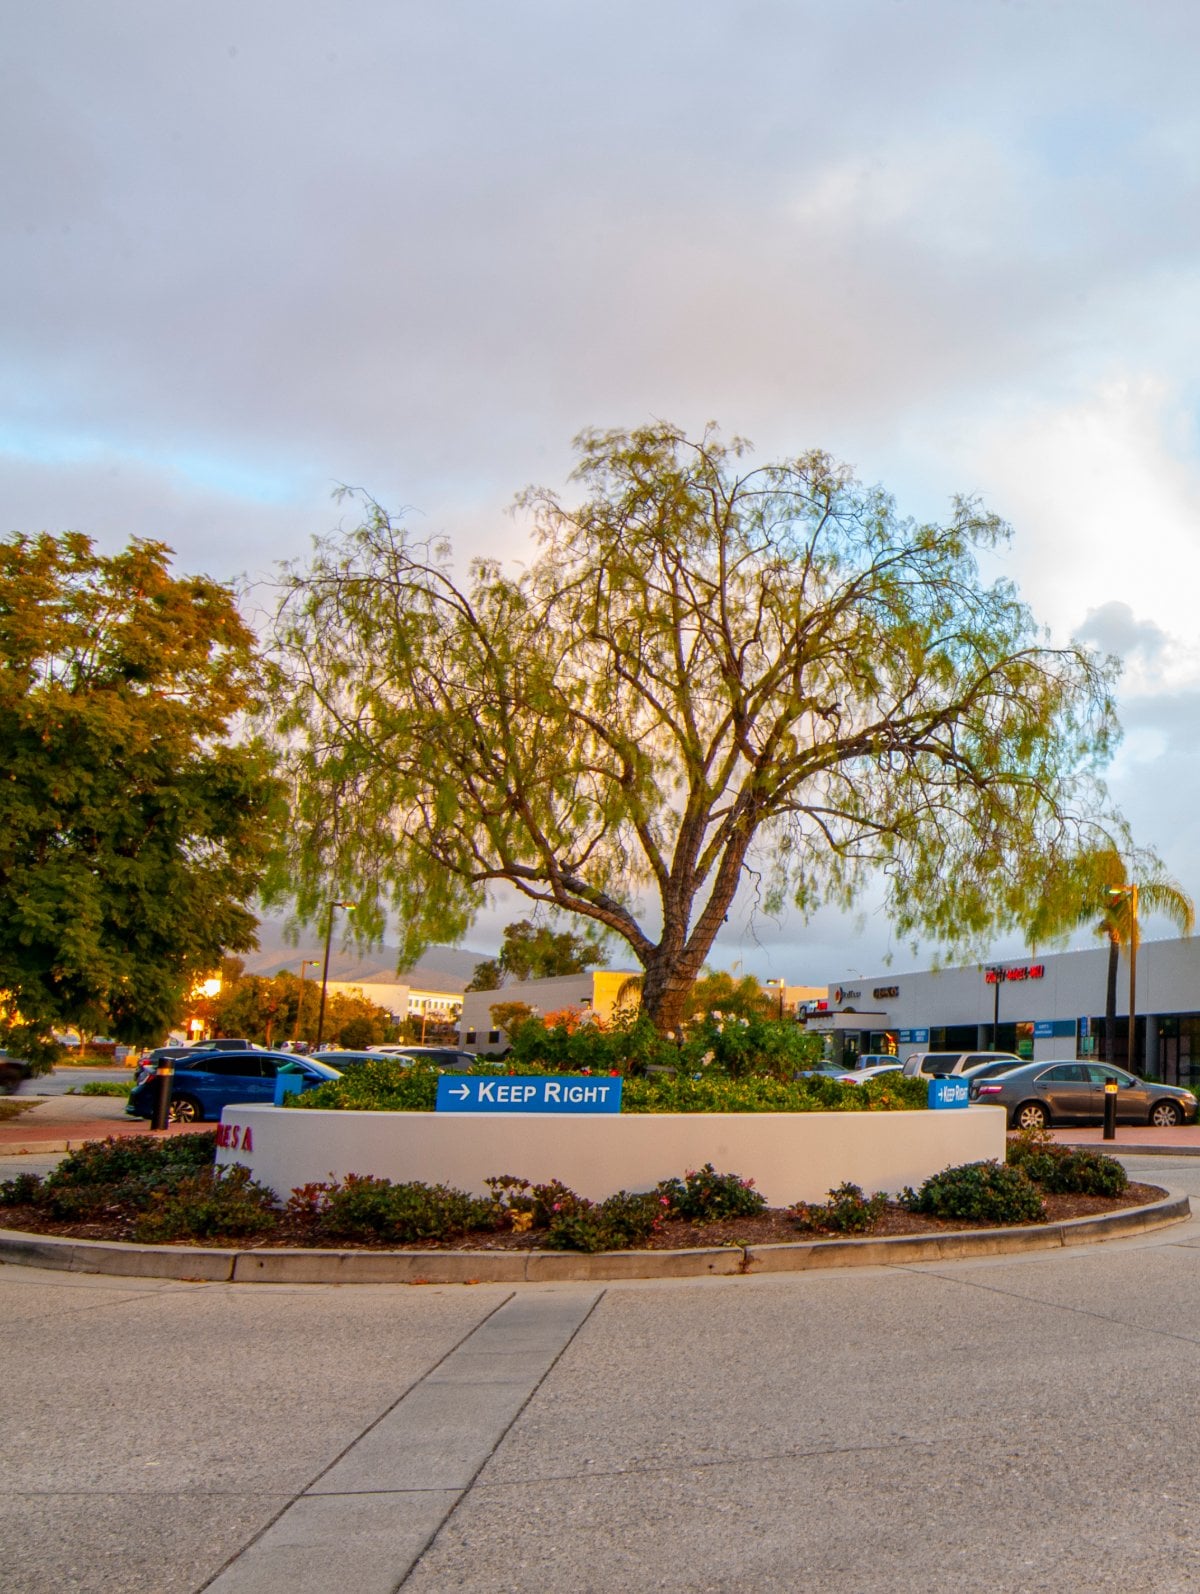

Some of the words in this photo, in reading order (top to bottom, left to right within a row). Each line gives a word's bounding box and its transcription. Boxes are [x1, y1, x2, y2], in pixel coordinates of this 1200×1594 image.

[478, 1082, 537, 1102] KEEP
[543, 1082, 610, 1103] RIGHT
[943, 1085, 955, 1102] KEEP
